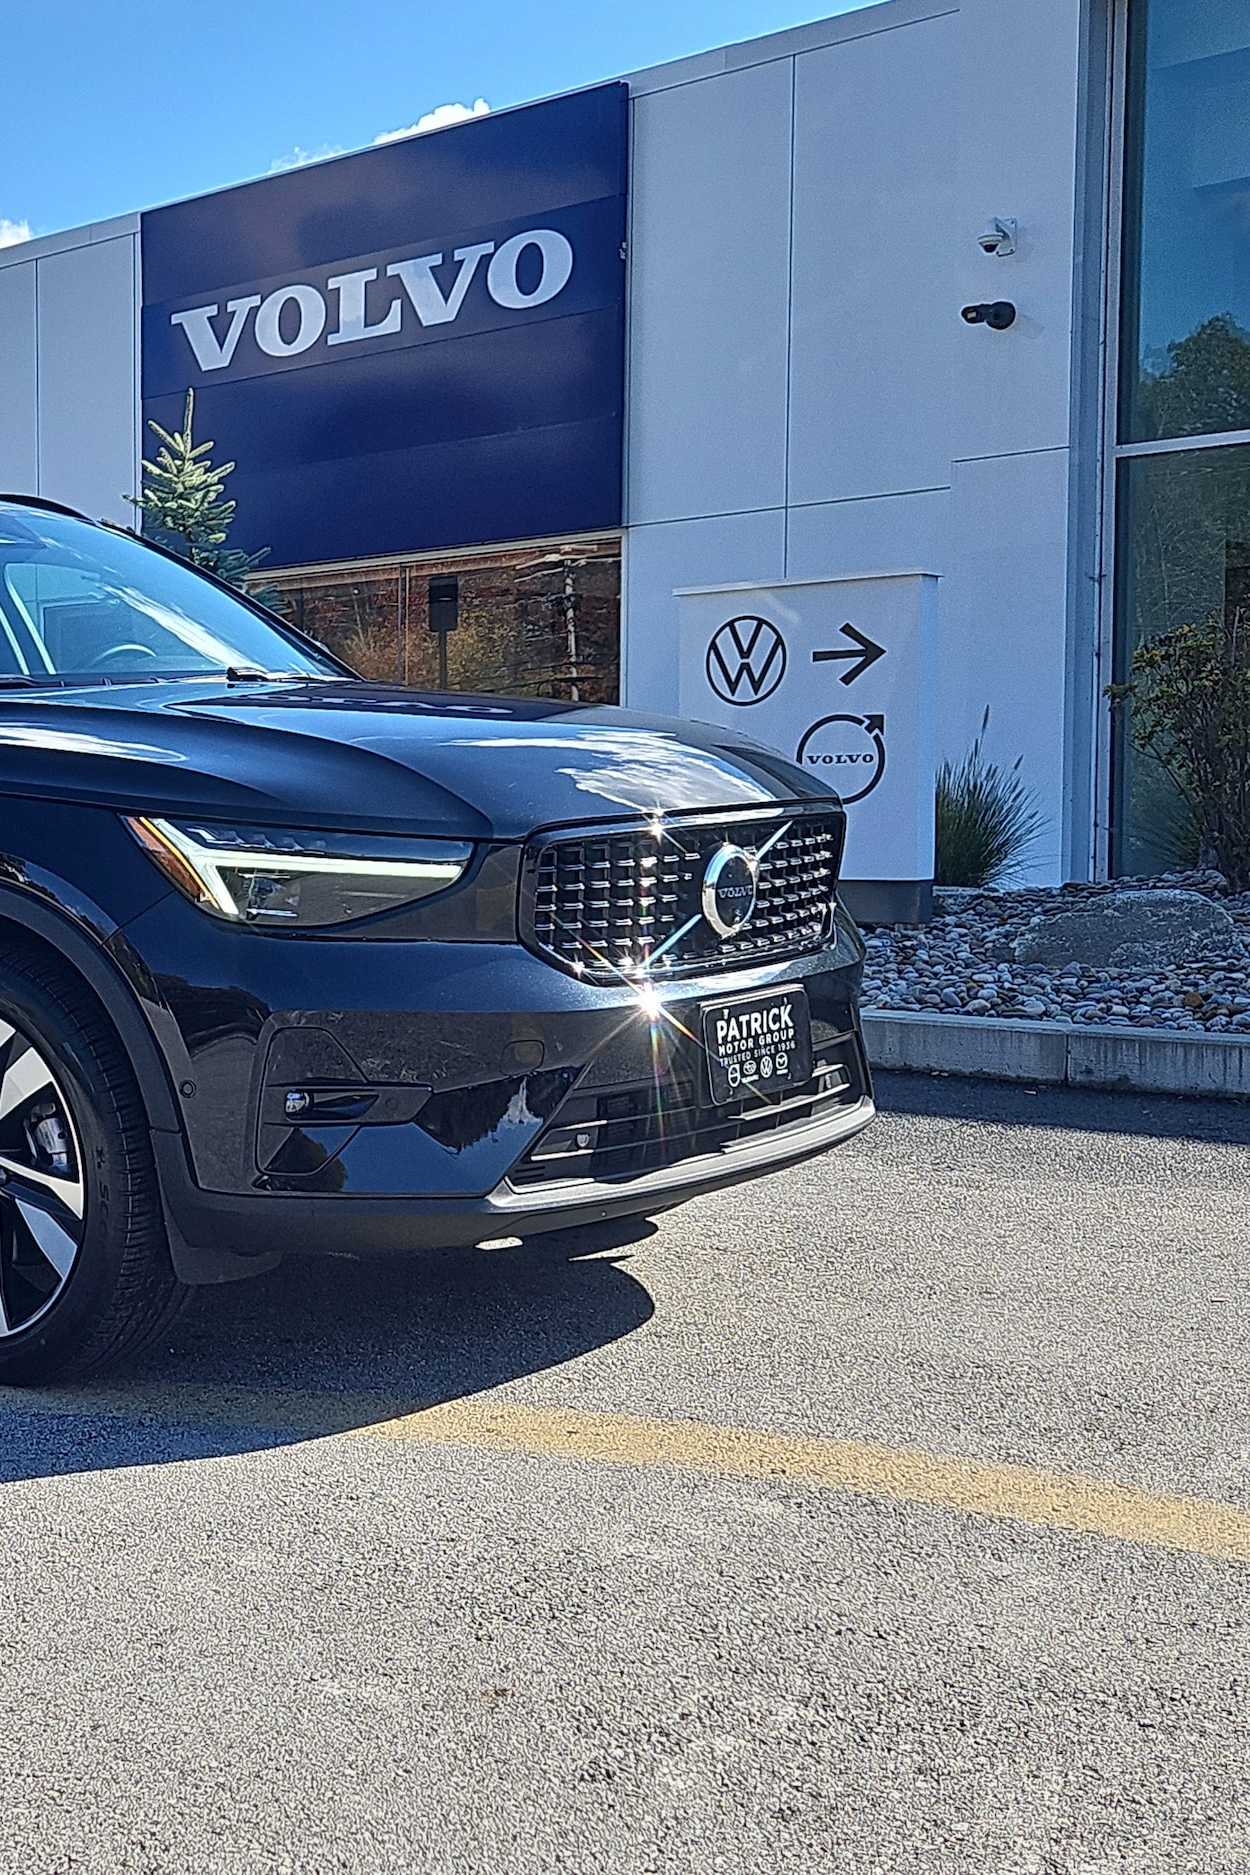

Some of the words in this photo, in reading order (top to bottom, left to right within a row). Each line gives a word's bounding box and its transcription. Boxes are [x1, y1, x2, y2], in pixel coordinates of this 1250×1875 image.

[171, 229, 573, 371] VOLVO
[807, 753, 874, 765] VOLVO
[716, 1004, 794, 1044] PATRICK
[718, 1038, 754, 1056] MOTOR
[758, 1028, 794, 1045] GROUP
[719, 1051, 752, 1068] TRUSTED
[754, 1044, 776, 1058] SINCE
